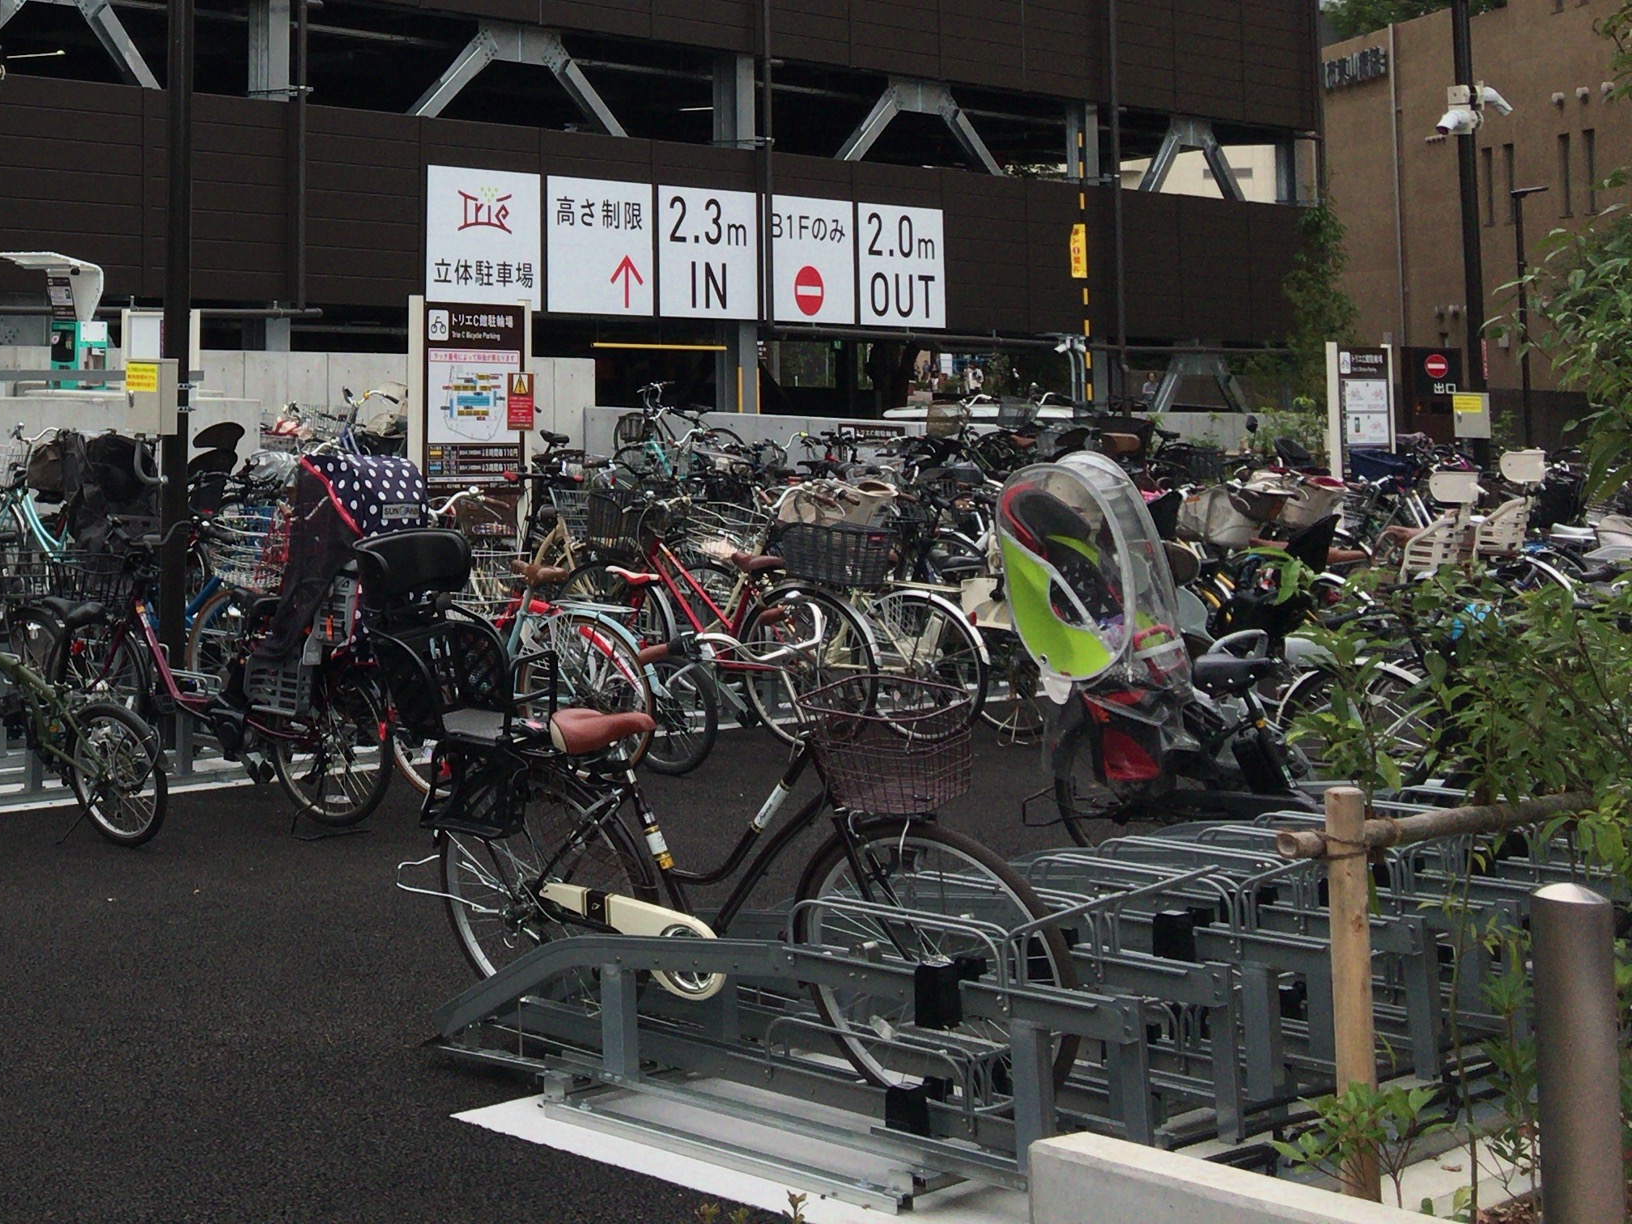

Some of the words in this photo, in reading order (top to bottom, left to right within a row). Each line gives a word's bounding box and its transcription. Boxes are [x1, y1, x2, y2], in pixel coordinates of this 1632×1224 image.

[556, 196, 643, 230] 高さ制限
[669, 195, 747, 247] 2.3m
[772, 213, 846, 243] B1Fのみ
[868, 212, 935, 260] 2.0m
[433, 258, 534, 288] 立体駐車場
[690, 261, 728, 310] IN
[870, 272, 936, 319] OUT
[1433, 382, 1457, 394] 出口
